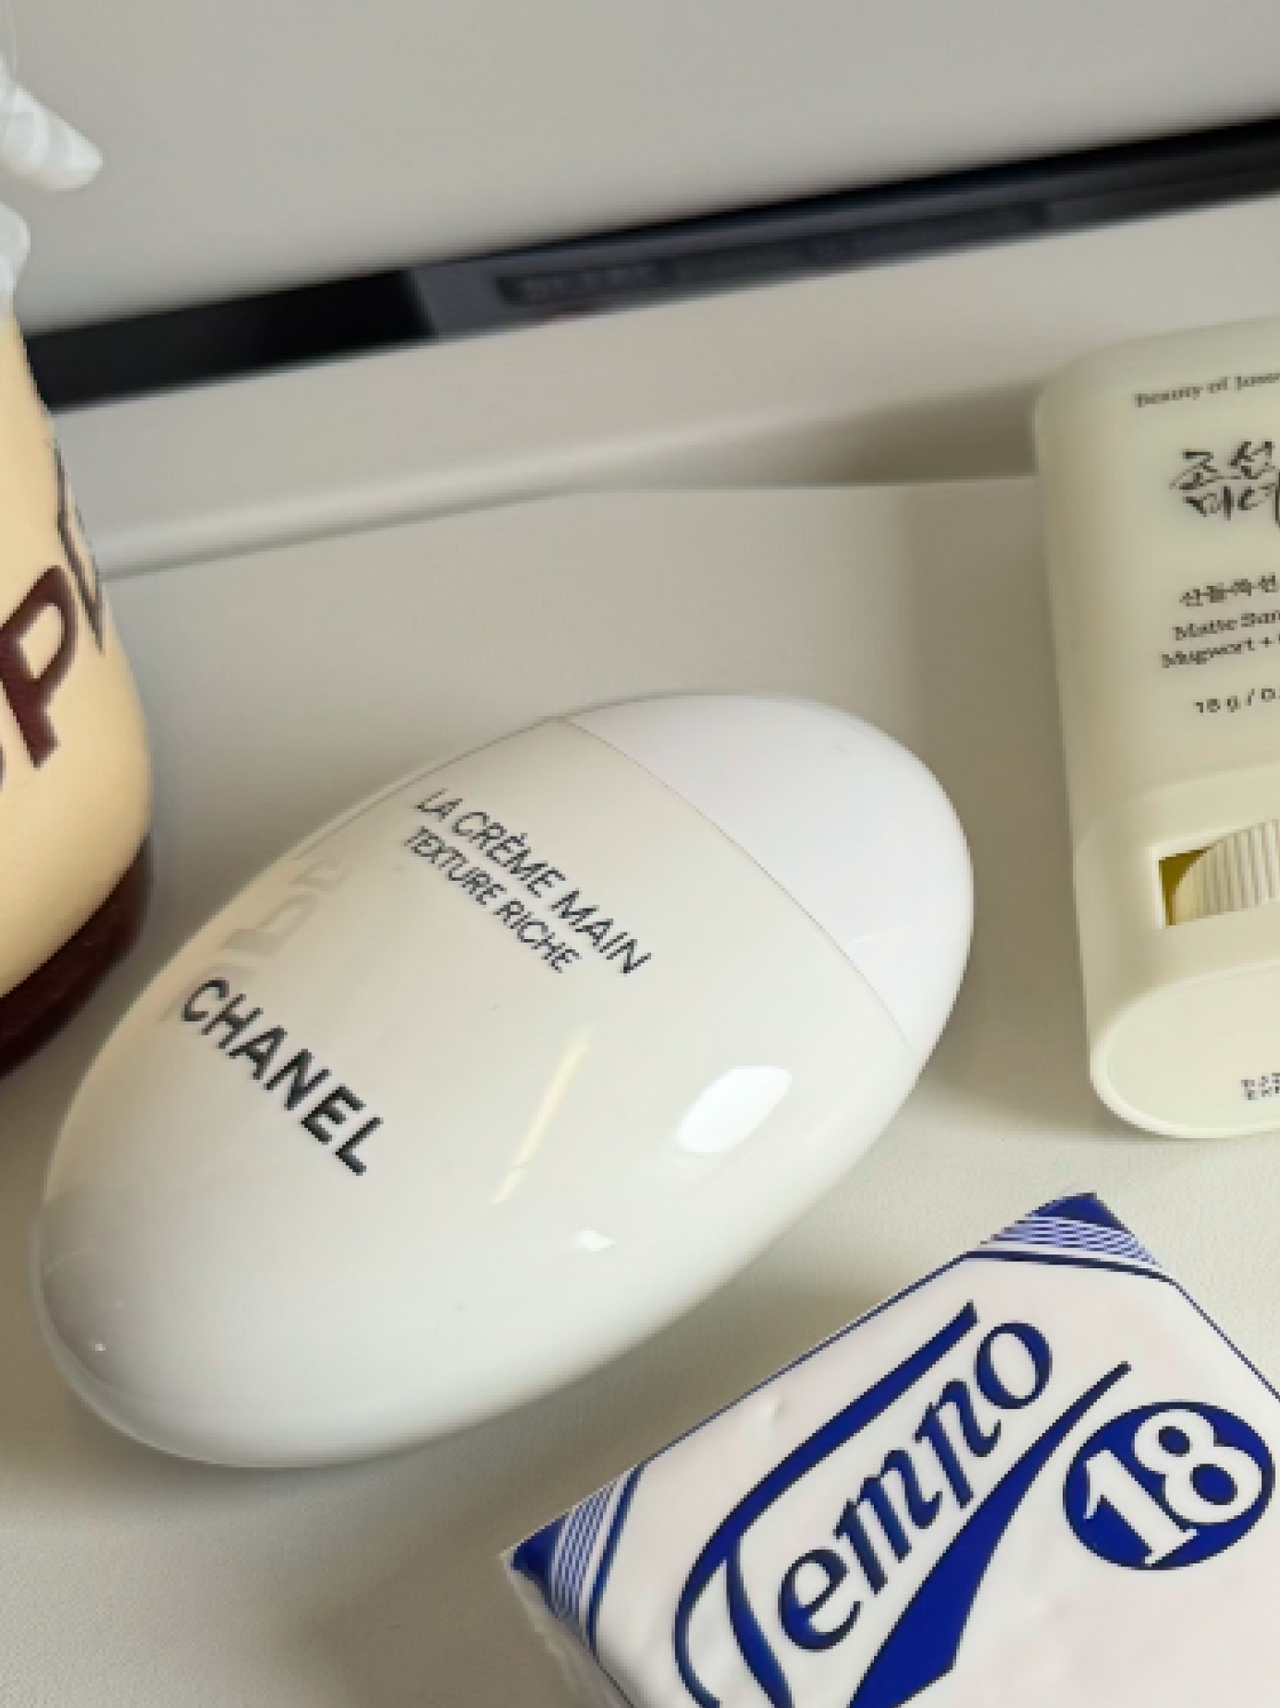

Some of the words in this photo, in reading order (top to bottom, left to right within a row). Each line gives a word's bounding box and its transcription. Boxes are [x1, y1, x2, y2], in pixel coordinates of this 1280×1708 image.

[1206, 376, 1230, 394] of
[1162, 637, 1255, 668] Mugwort
[1173, 620, 1238, 641] Matte
[1194, 699, 1221, 713] 18
[1227, 696, 1241, 713] g
[404, 826, 505, 905] TEXTURE
[493, 898, 582, 973] RICHE
[415, 788, 462, 819] LA
[452, 812, 565, 898] CRÈME
[551, 891, 651, 974] MAIN
[181, 980, 383, 1176] CHANEL
[1083, 1405, 1261, 1568] 18
